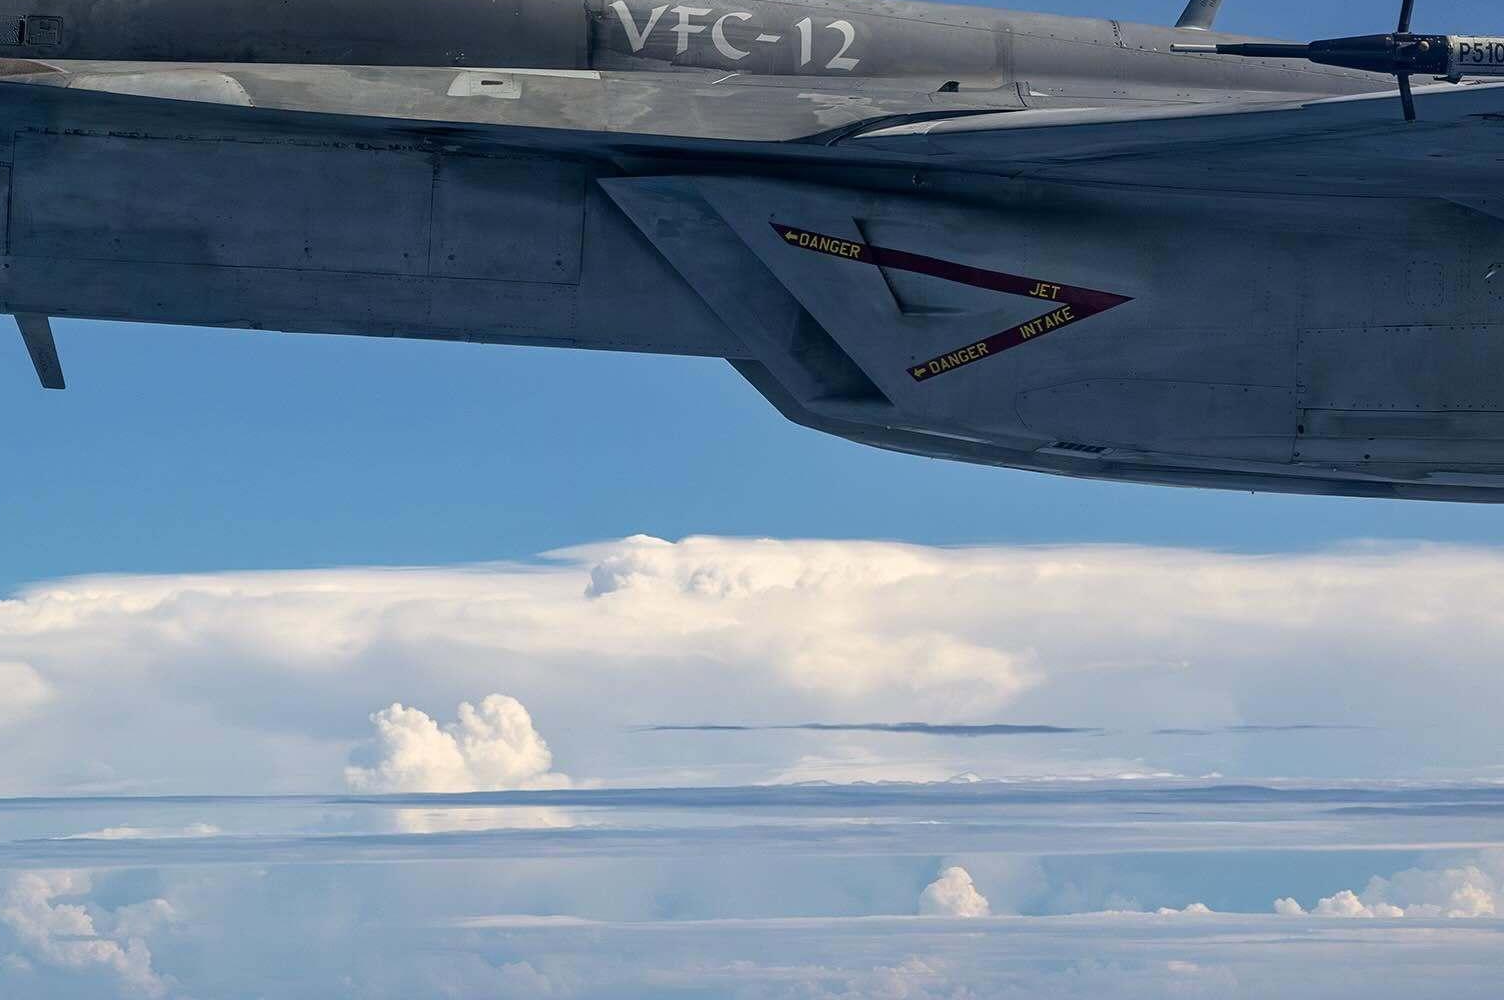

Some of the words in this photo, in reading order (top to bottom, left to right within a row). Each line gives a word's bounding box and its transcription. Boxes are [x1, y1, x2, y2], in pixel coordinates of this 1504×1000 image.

[609, 0, 860, 72] VFC-12
[799, 233, 861, 258] DANGER
[1029, 283, 1061, 300] JET
[1019, 306, 1075, 340] INTAKE
[928, 341, 990, 376] DANGER
